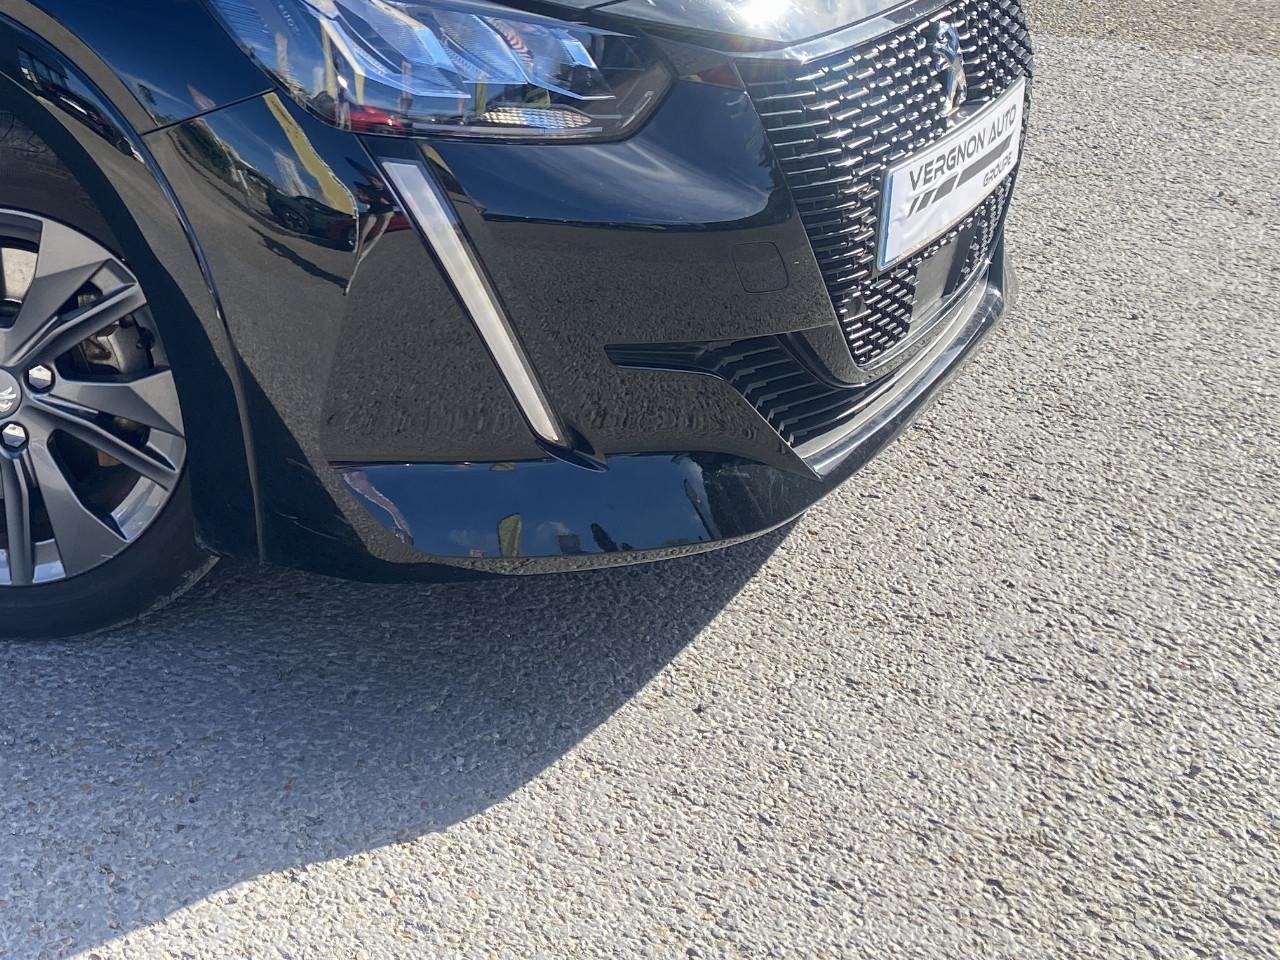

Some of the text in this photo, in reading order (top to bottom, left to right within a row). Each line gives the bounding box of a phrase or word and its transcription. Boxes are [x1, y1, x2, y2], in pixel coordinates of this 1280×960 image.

[909, 104, 1017, 191] VERGNON AUTO
[982, 151, 1013, 187] GROUPE
